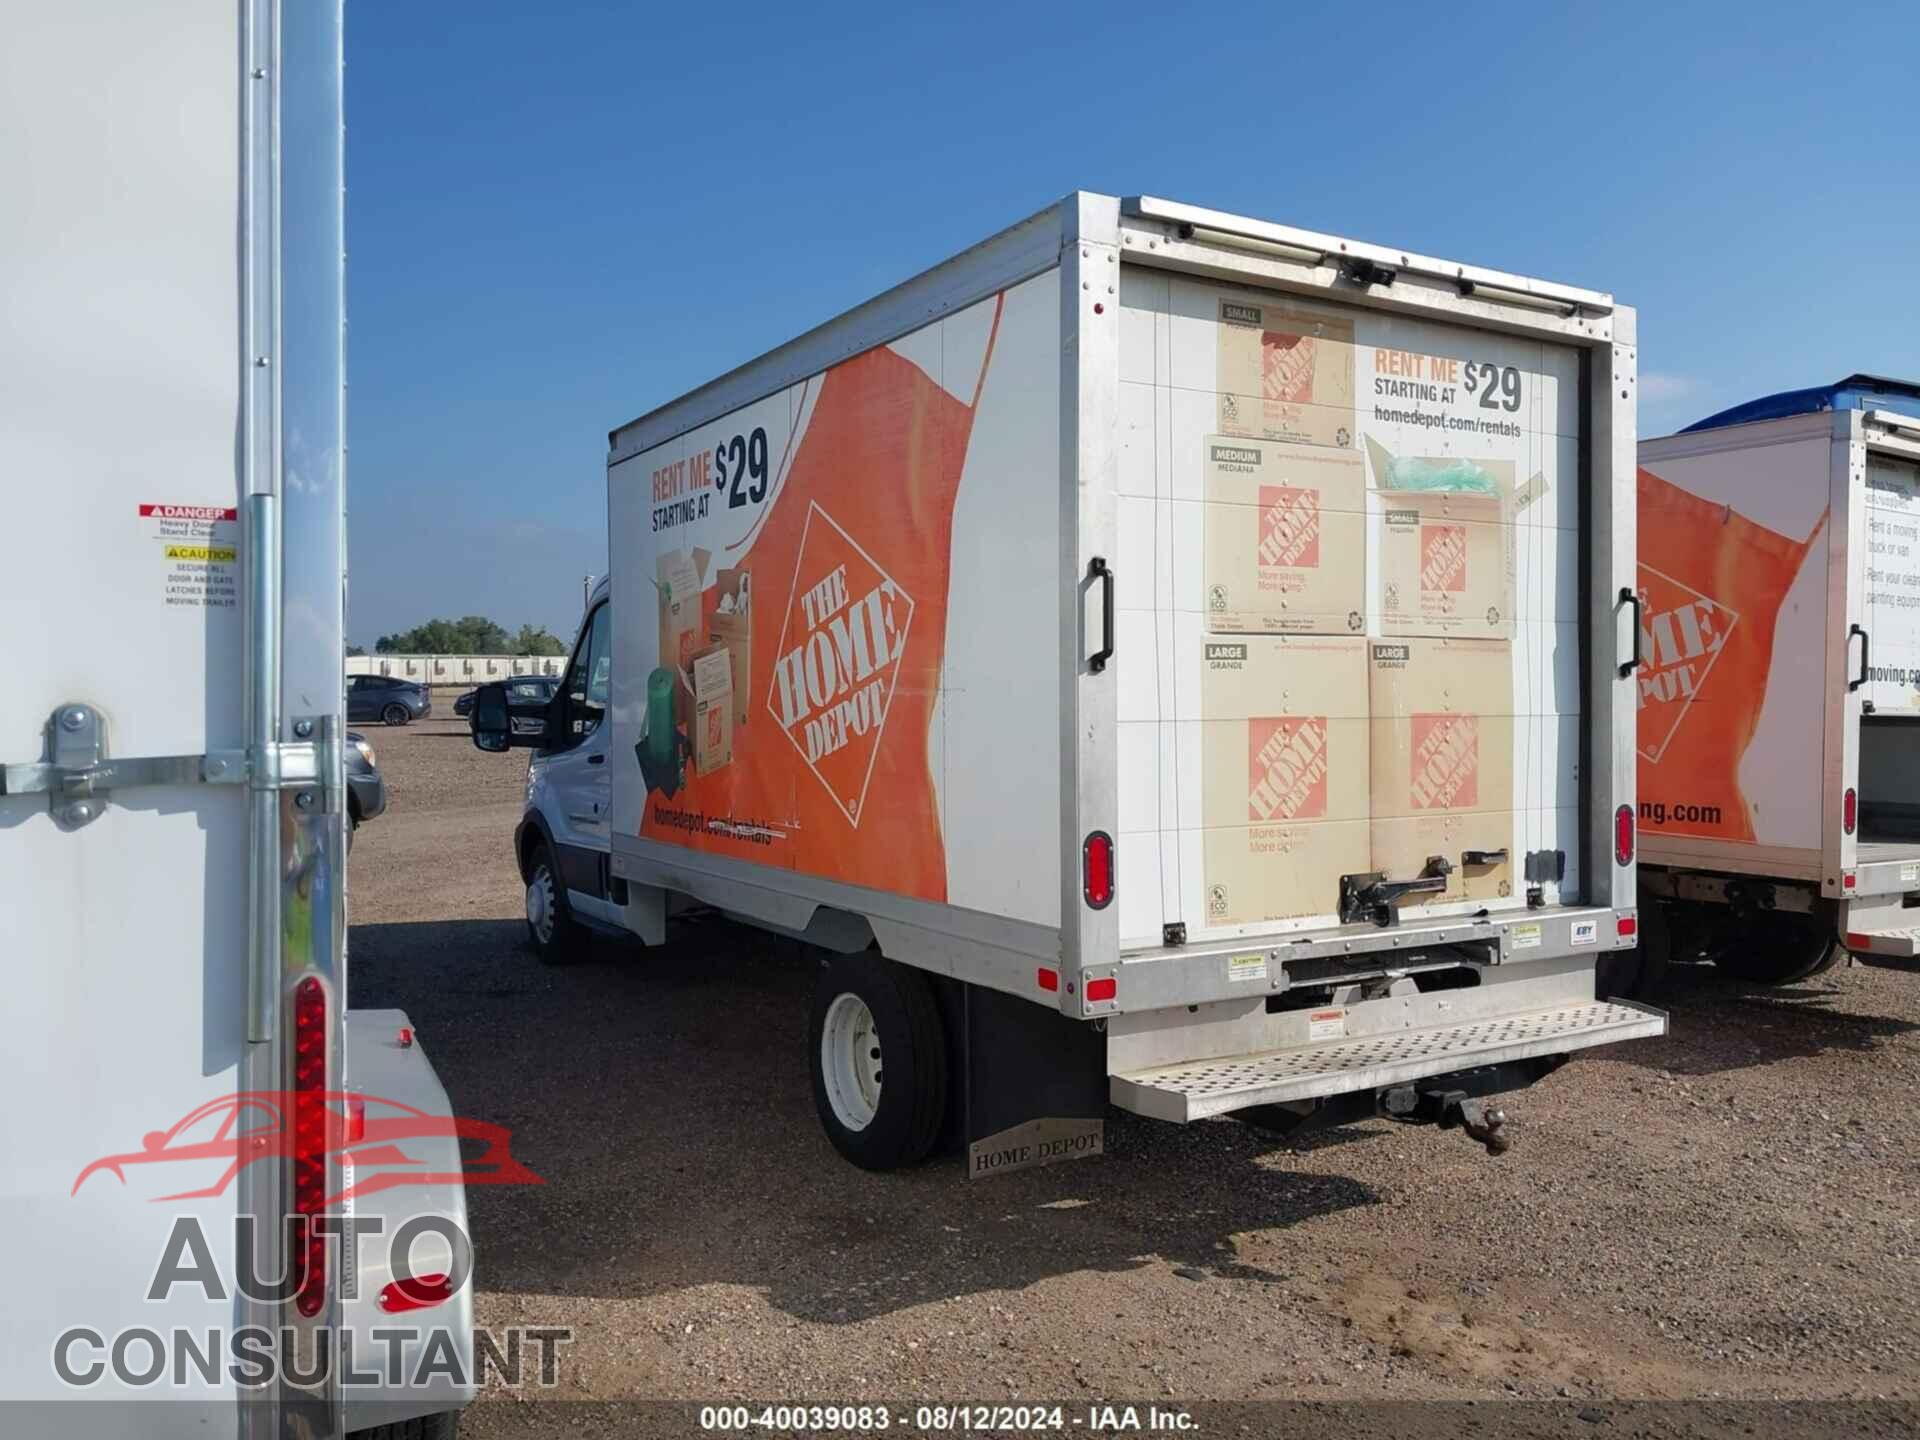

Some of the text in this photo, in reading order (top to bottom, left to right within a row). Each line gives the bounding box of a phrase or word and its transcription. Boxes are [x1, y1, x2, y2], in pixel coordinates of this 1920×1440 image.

[1225, 305, 1258, 321] SMALL
[1375, 348, 1458, 383] RENT ME
[1375, 377, 1456, 404] STARTING AT
[1463, 360, 1522, 413] $29
[1375, 404, 1521, 438] homedepot.com/rentals
[715, 427, 768, 509] $29
[1215, 449, 1257, 462] MEDIUM
[1218, 464, 1254, 473] MEDIANA
[652, 450, 711, 504] RENT ME
[160, 519, 216, 529] Heavy Door
[164, 507, 225, 520] DANGER
[652, 493, 710, 532] STARTING AT
[1260, 488, 1320, 565] HOME
[160, 528, 217, 537] Stand Clear
[180, 548, 236, 560] CAUTION
[801, 564, 850, 632] THE
[1637, 600, 1722, 670] ME
[776, 579, 902, 730] HOME
[1208, 646, 1243, 659] LARGE
[1209, 661, 1243, 670] GRANDE
[1376, 647, 1405, 659] LARGE
[1377, 661, 1406, 670] GRANDE
[1637, 664, 1697, 711] POT
[804, 678, 886, 765] DEPOT
[1249, 716, 1328, 821] HOME
[1410, 714, 1478, 809] HOME
[1280, 752, 1328, 819] DEPOT
[1640, 801, 1722, 825] ng.com
[1576, 926, 1593, 935] EBY
[976, 1132, 1099, 1171] HOME DEPOT
